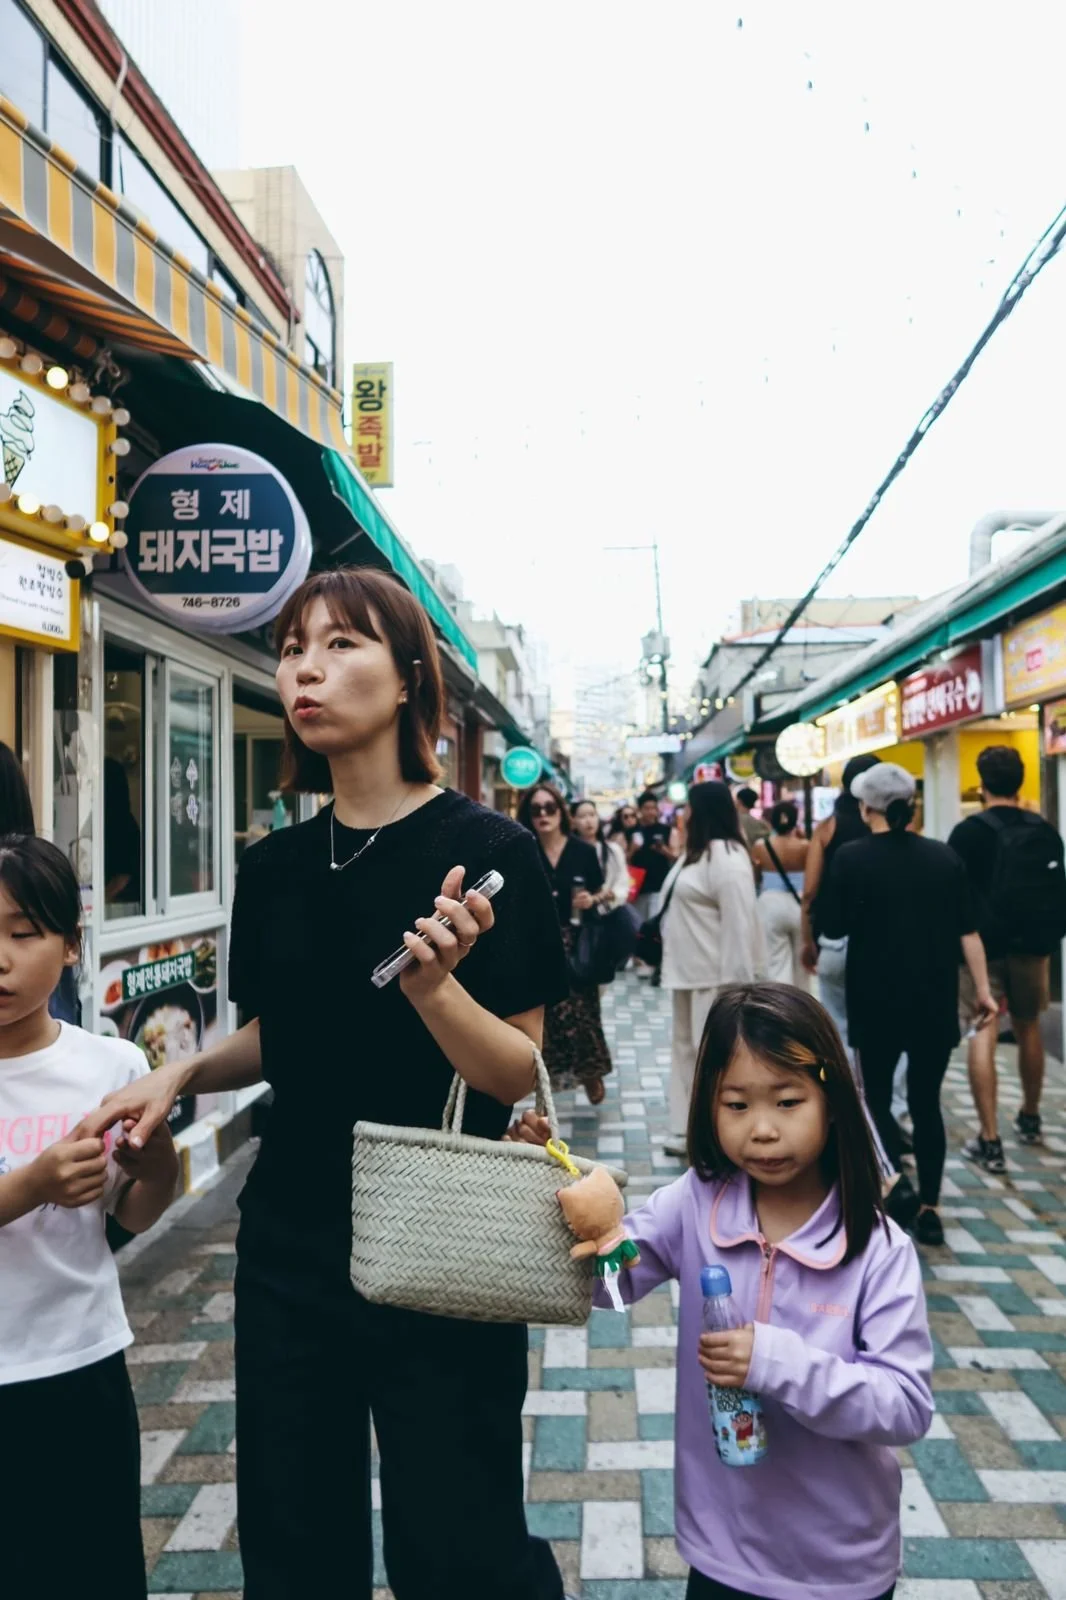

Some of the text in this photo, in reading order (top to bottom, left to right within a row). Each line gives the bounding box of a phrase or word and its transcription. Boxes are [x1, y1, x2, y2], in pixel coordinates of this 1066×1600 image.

[356, 379, 386, 468] 왕족발
[138, 529, 283, 573] 돼지국밥
[182, 596, 240, 608] 746-8726
